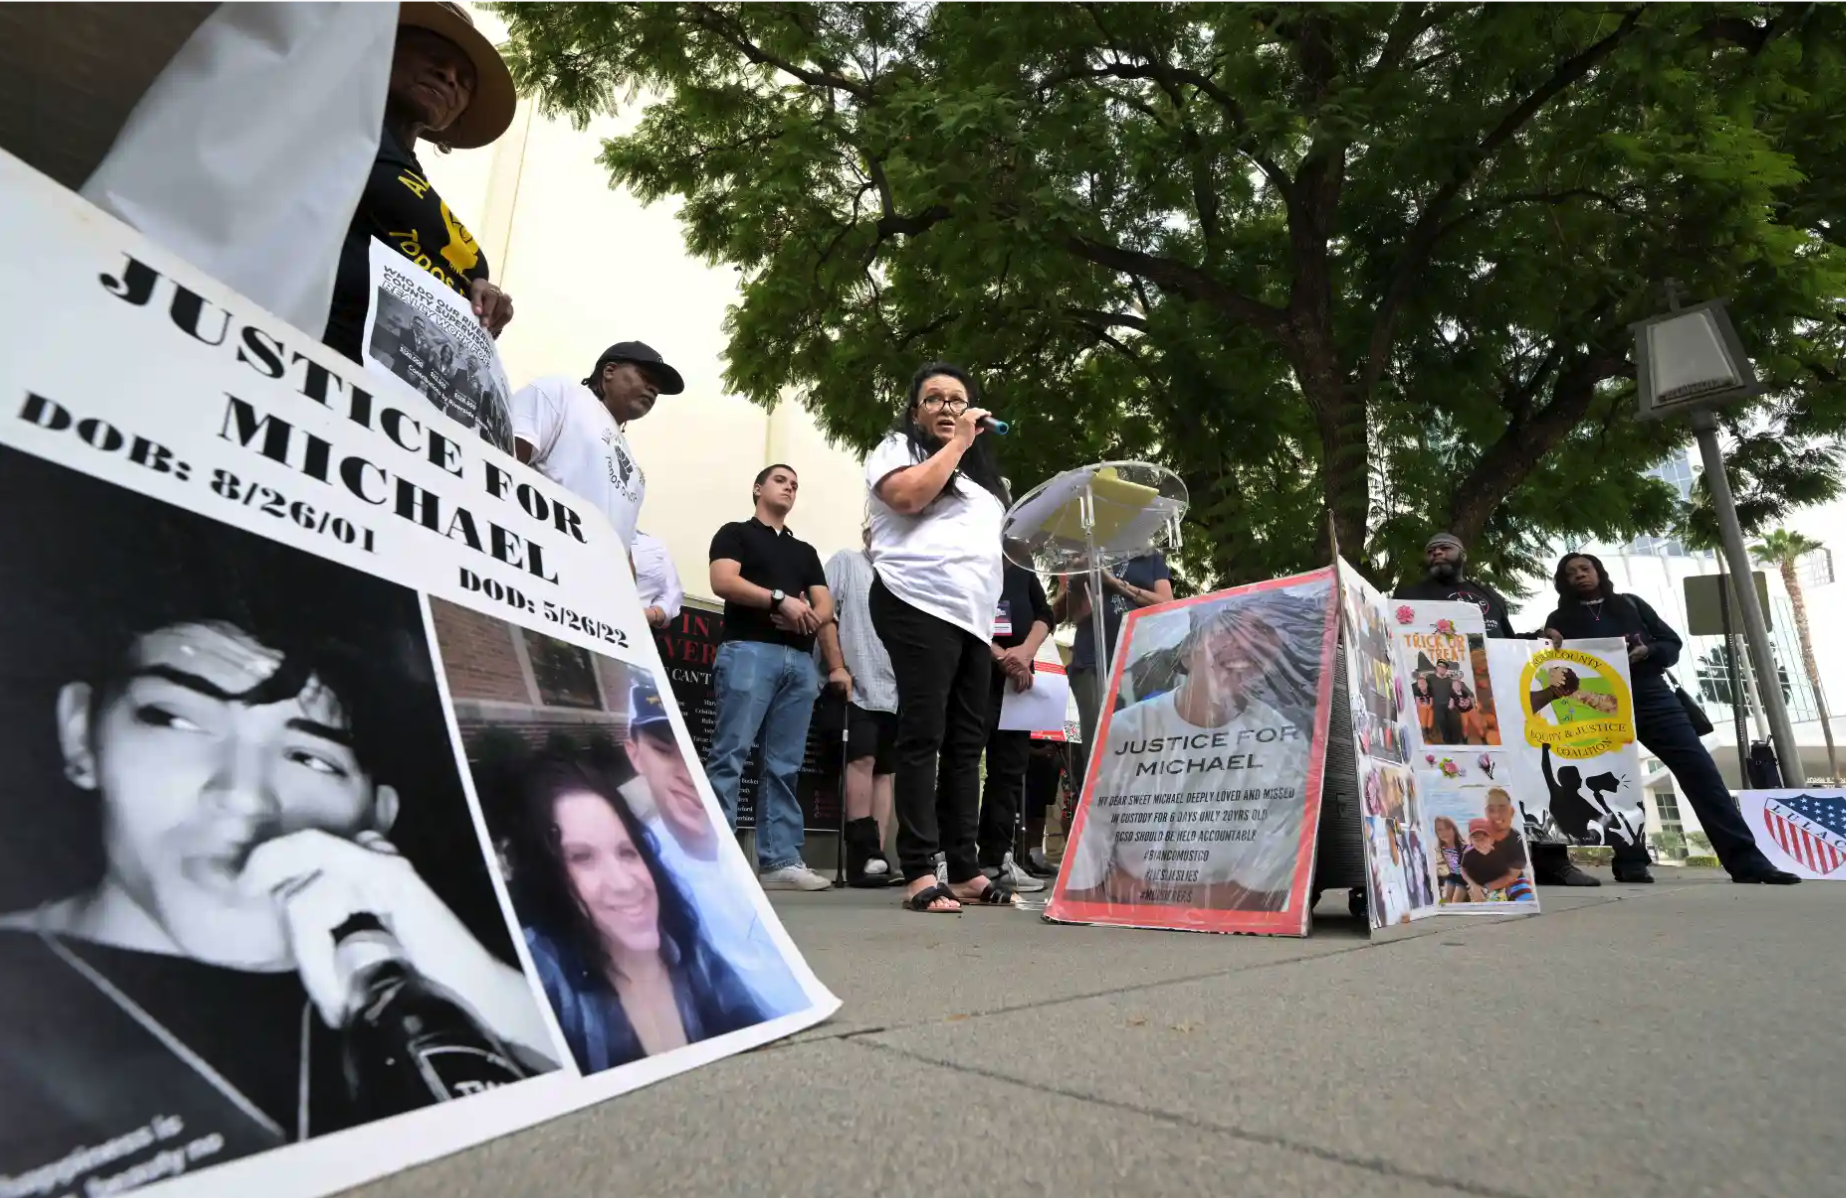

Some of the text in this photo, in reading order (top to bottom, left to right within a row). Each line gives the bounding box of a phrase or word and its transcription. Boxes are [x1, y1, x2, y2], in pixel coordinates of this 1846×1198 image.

[383, 273, 434, 306] COUNTY
[384, 265, 414, 288] WHO
[417, 286, 434, 300] DO
[437, 299, 460, 317] OUR
[381, 281, 437, 317] REALLY
[436, 314, 470, 350] WORK
[98, 251, 588, 545] JUSTICE FOR
[18, 391, 379, 555] DOB: 8/26/01
[218, 392, 559, 586] MICHAEL
[458, 566, 629, 649] DOD: 5/26/22
[682, 613, 710, 637] IN
[1404, 634, 1442, 648] TRICK
[1428, 649, 1466, 661] TREAT
[672, 668, 712, 685] CAN'T
[1115, 726, 1299, 755] JUSTICE FOR
[1565, 730, 1573, 738] &
[1575, 722, 1626, 736] JUSTICE
[1557, 737, 1612, 757] COALITION
[1135, 754, 1263, 776] MICHAEL
[1109, 795, 1127, 806] DEAR
[1128, 794, 1151, 805] SWEET
[1153, 793, 1183, 804] MICHAEL
[1186, 791, 1215, 803] DEEPLY
[1216, 790, 1241, 802] LOVED
[1243, 789, 1260, 800] AND
[1262, 788, 1295, 799] MISSED
[1111, 814, 1118, 823] IN
[1120, 812, 1152, 823] CUSTODY
[1153, 811, 1167, 823] FOR
[1177, 811, 1197, 822] DAYS
[1200, 810, 1220, 821] ONLY
[1222, 809, 1249, 821] 20YRS
[1251, 809, 1268, 821] OLD
[1134, 831, 1163, 842] SHOULD
[1165, 831, 1175, 842] BE
[1197, 829, 1257, 842] ACCOUNTABLE
